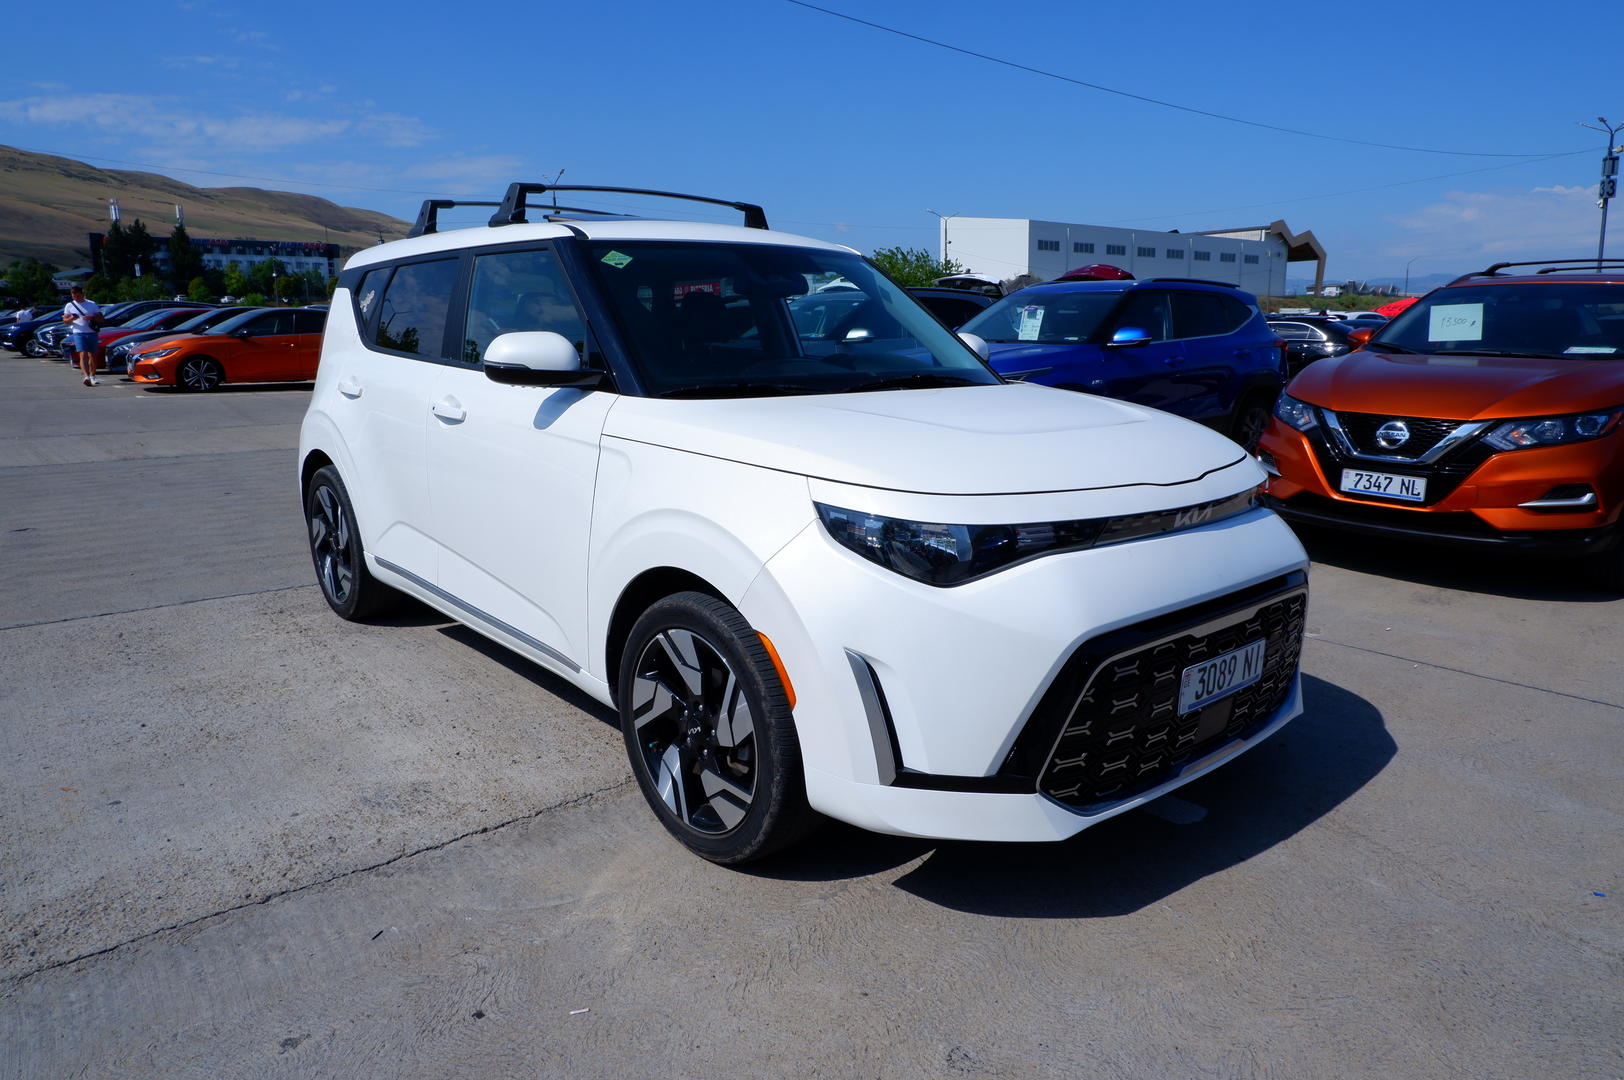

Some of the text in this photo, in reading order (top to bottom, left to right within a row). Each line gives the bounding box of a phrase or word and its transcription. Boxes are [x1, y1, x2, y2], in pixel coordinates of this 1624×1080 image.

[1354, 473, 1421, 496] 7347 NL
[1195, 643, 1261, 701] 3089 NI
